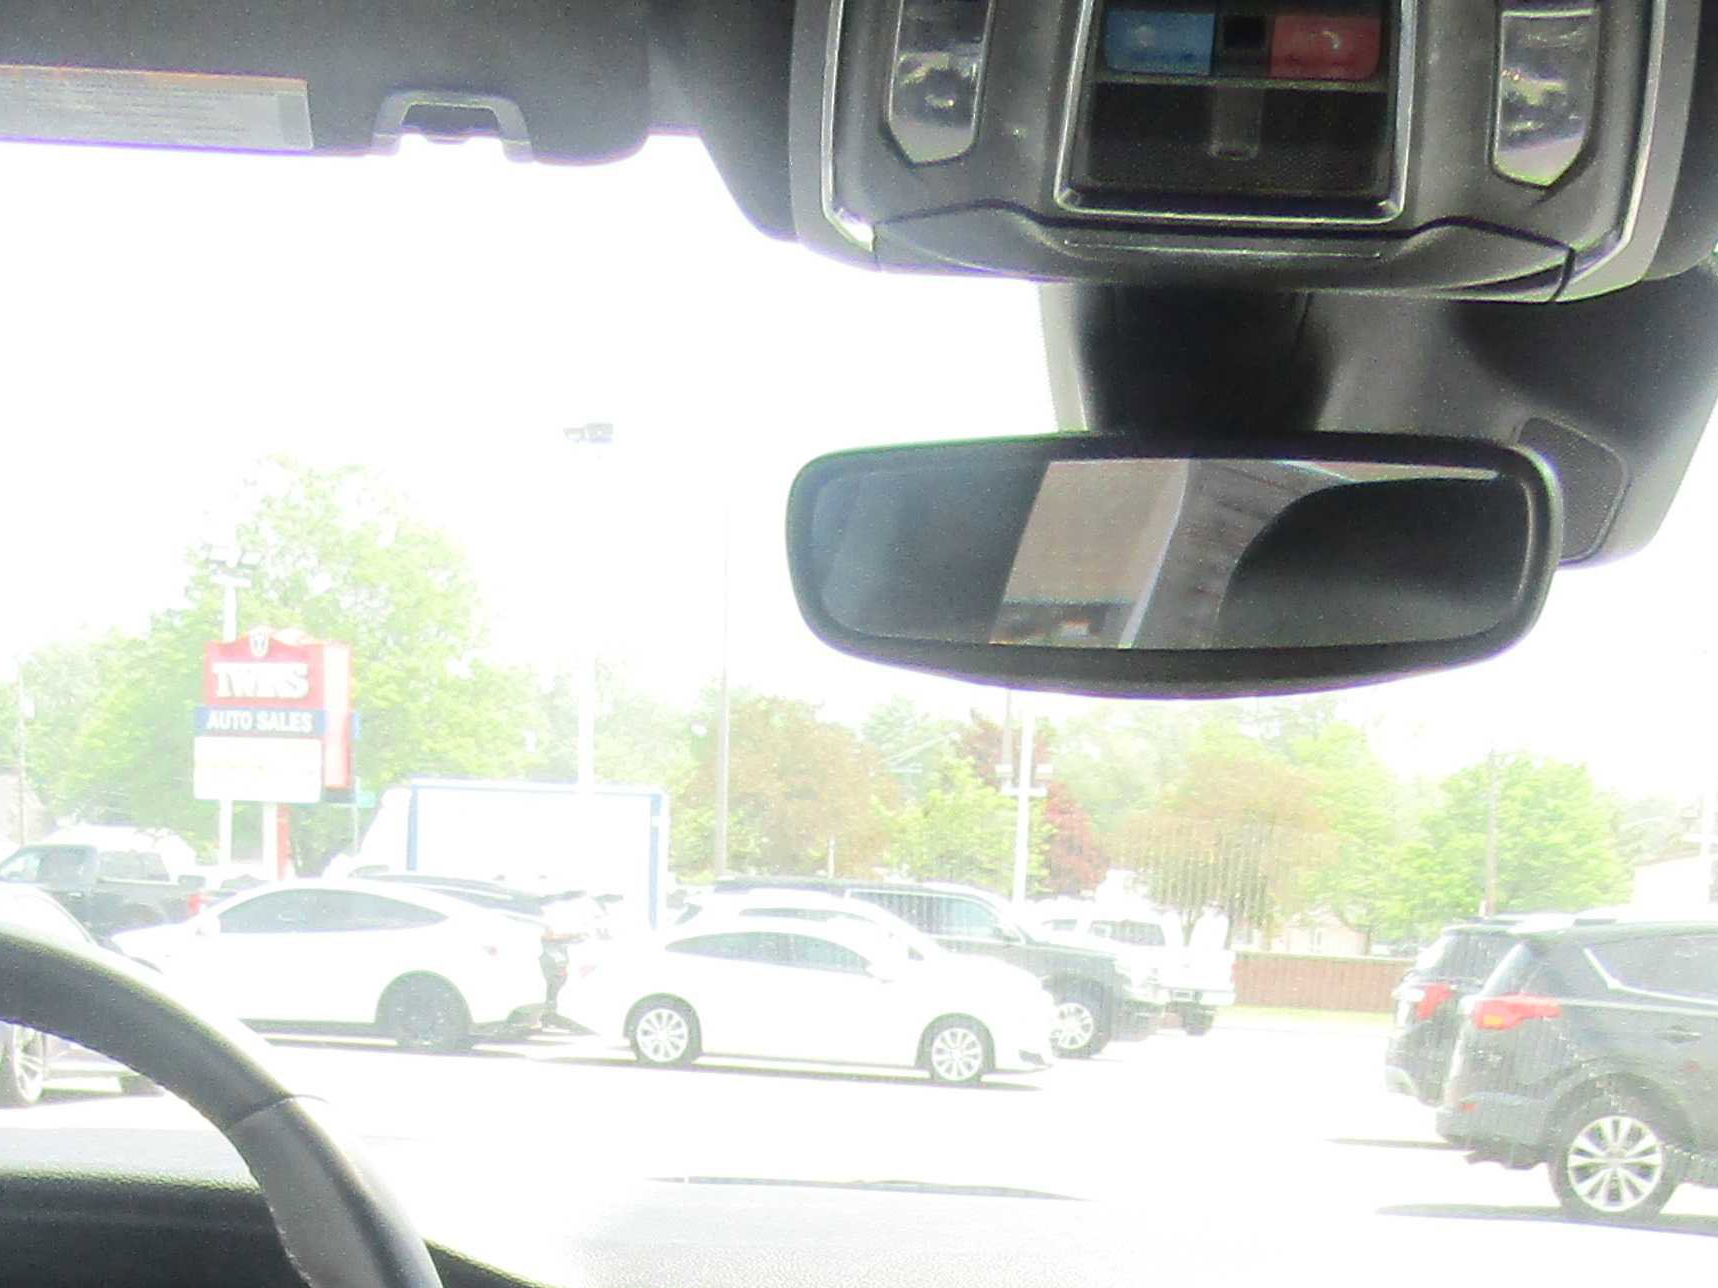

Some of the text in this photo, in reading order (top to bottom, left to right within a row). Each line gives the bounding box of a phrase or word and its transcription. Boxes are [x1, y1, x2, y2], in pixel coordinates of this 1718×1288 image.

[213, 662, 309, 699] TWINS
[206, 710, 312, 733] AUTO SALES
